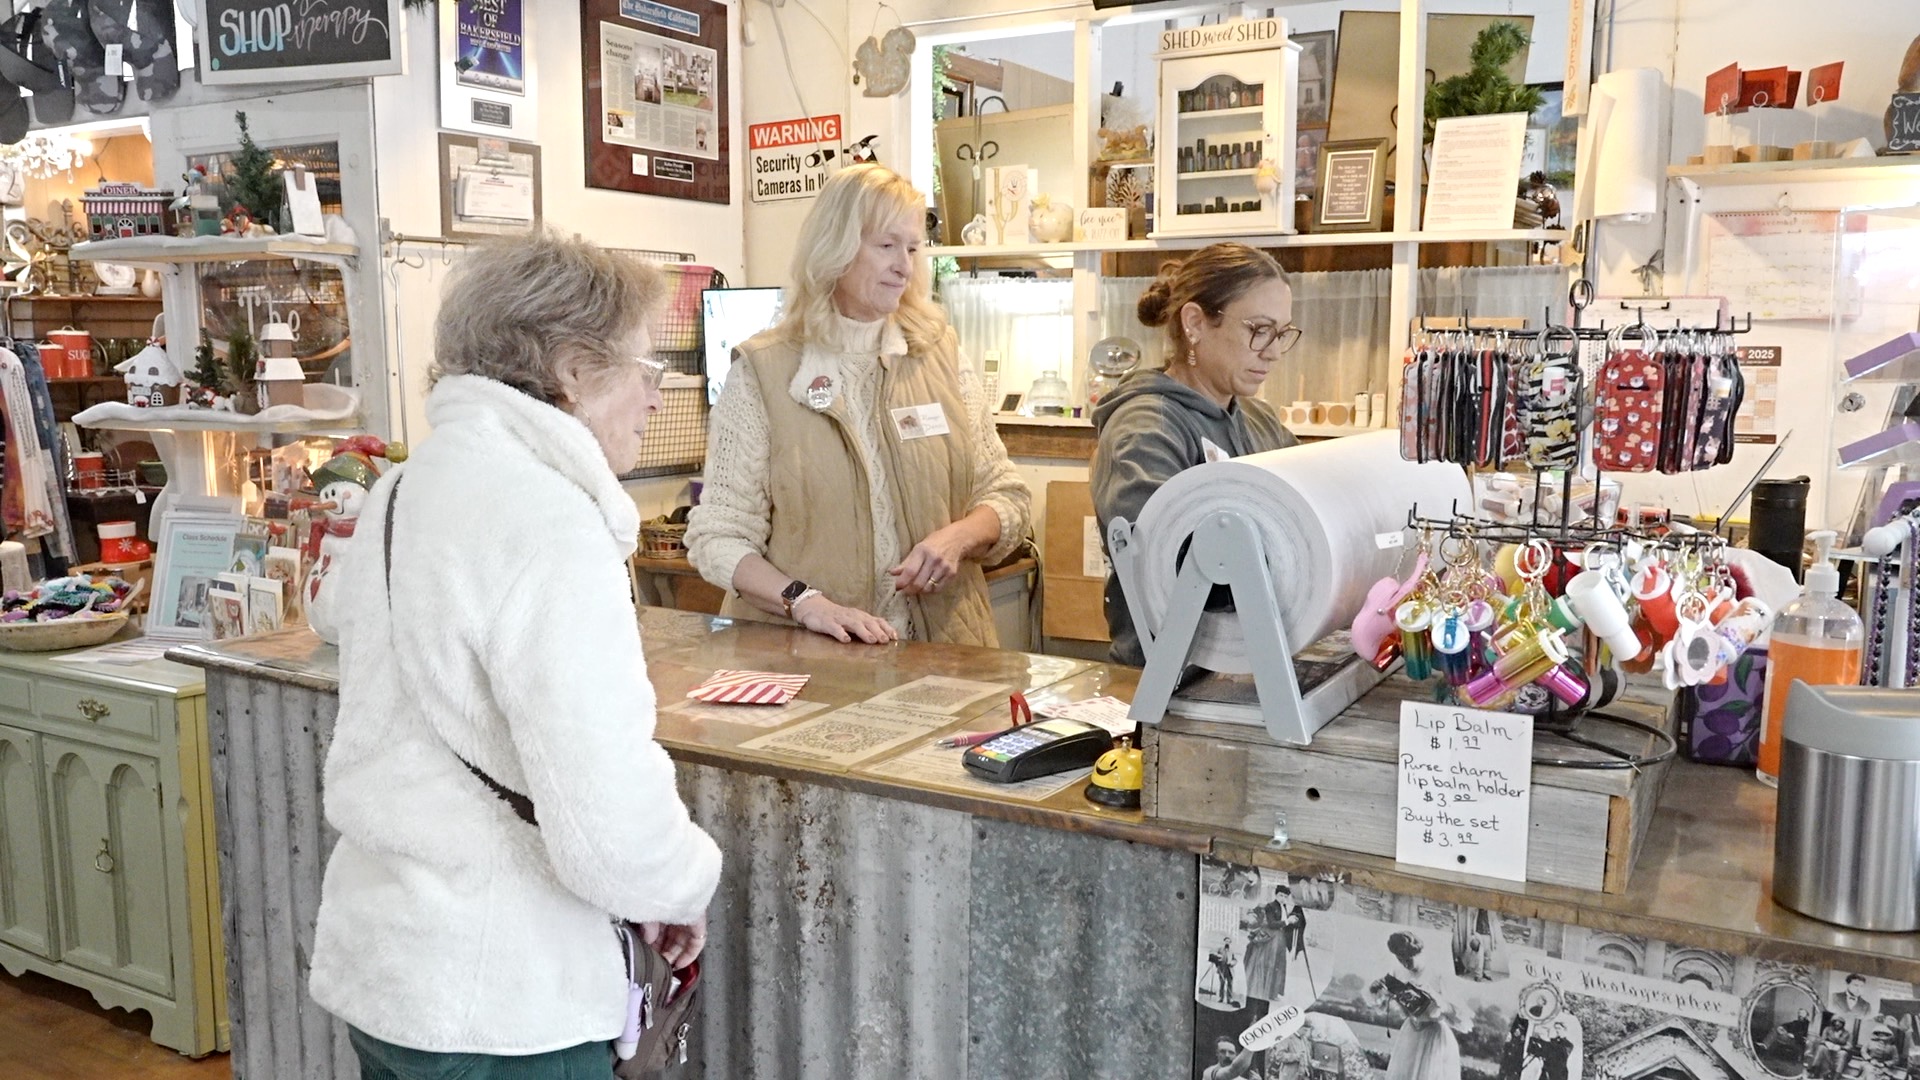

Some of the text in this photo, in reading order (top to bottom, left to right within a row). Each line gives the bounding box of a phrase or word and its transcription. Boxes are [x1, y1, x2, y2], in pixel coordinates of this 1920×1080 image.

[219, 3, 291, 56] SHOP
[484, 12, 498, 27] OF
[459, 22, 520, 46] BAKERSFIELD
[605, 38, 633, 51] Seasons
[1163, 20, 1277, 51] SHED sweet SHED
[605, 48, 631, 61] change
[753, 119, 837, 148] WARNING
[756, 153, 802, 174] Security
[105, 186, 138, 196] DINER
[757, 178, 802, 197] Cameras
[805, 174, 815, 192] In
[1748, 349, 1775, 360] 2025
[182, 533, 200, 542] Class
[1415, 710, 1513, 741] Lip Balm
[1401, 753, 1508, 781] Purse charm
[1407, 773, 1526, 798] lip balm holder
[1401, 807, 1500, 832] Buy the set
[1524, 958, 1724, 1014] The Photographer
